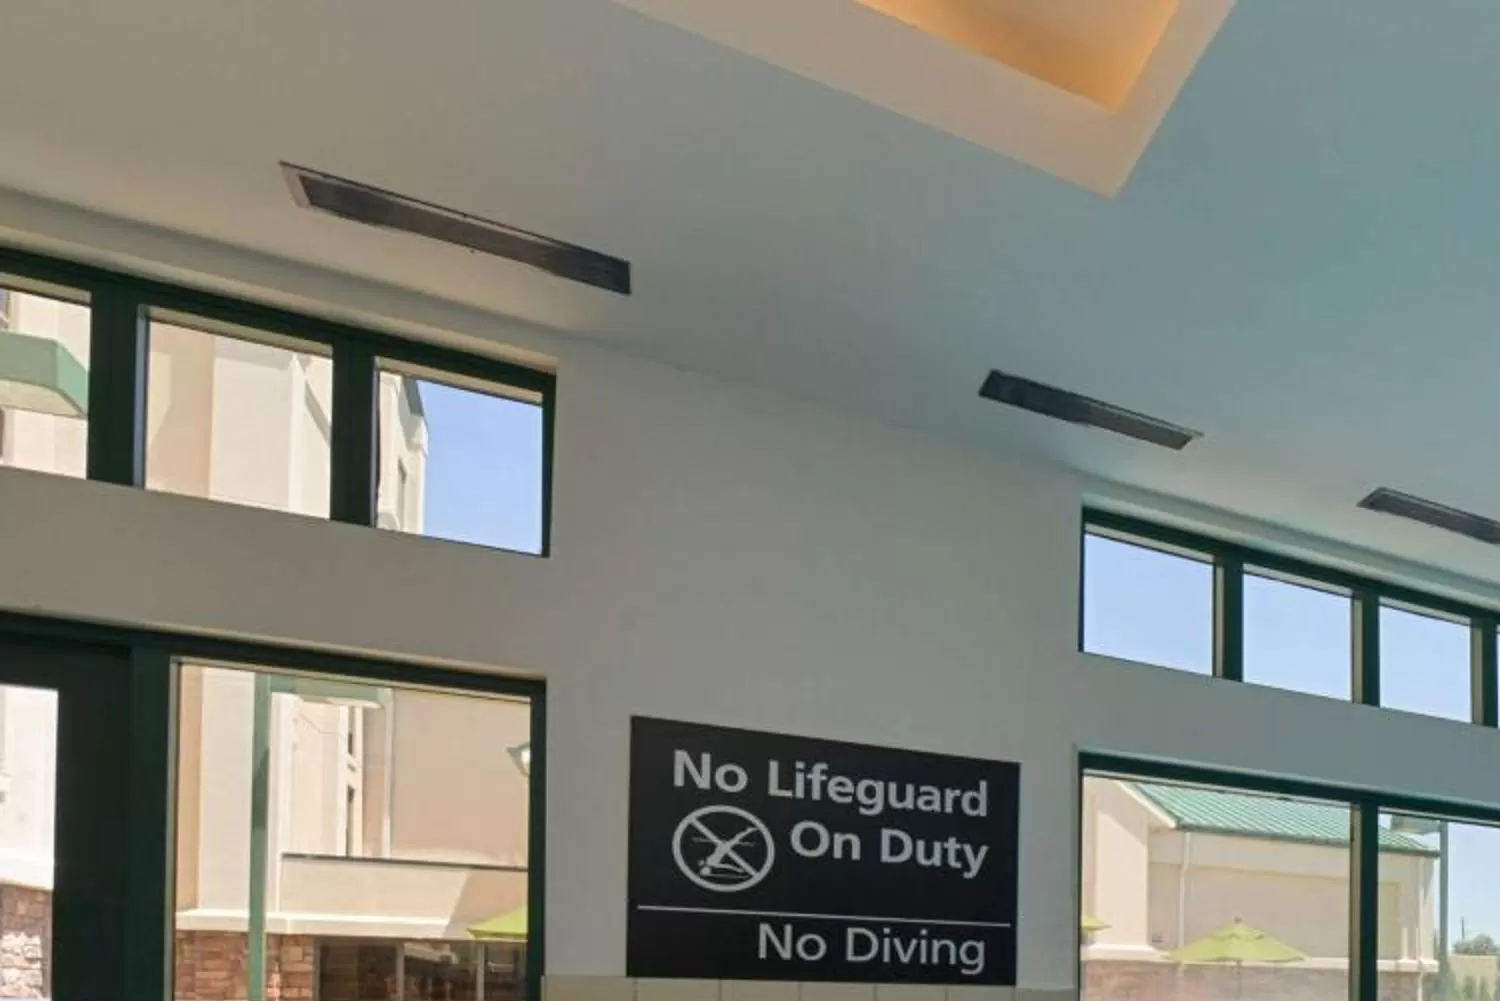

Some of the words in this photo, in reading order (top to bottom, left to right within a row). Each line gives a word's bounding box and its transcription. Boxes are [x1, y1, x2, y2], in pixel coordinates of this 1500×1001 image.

[672, 749, 749, 793] No
[768, 760, 988, 817] Lifeguard
[790, 820, 861, 861] On
[880, 828, 989, 878] Duty
[758, 923, 827, 961] No
[846, 926, 986, 975] Diving
